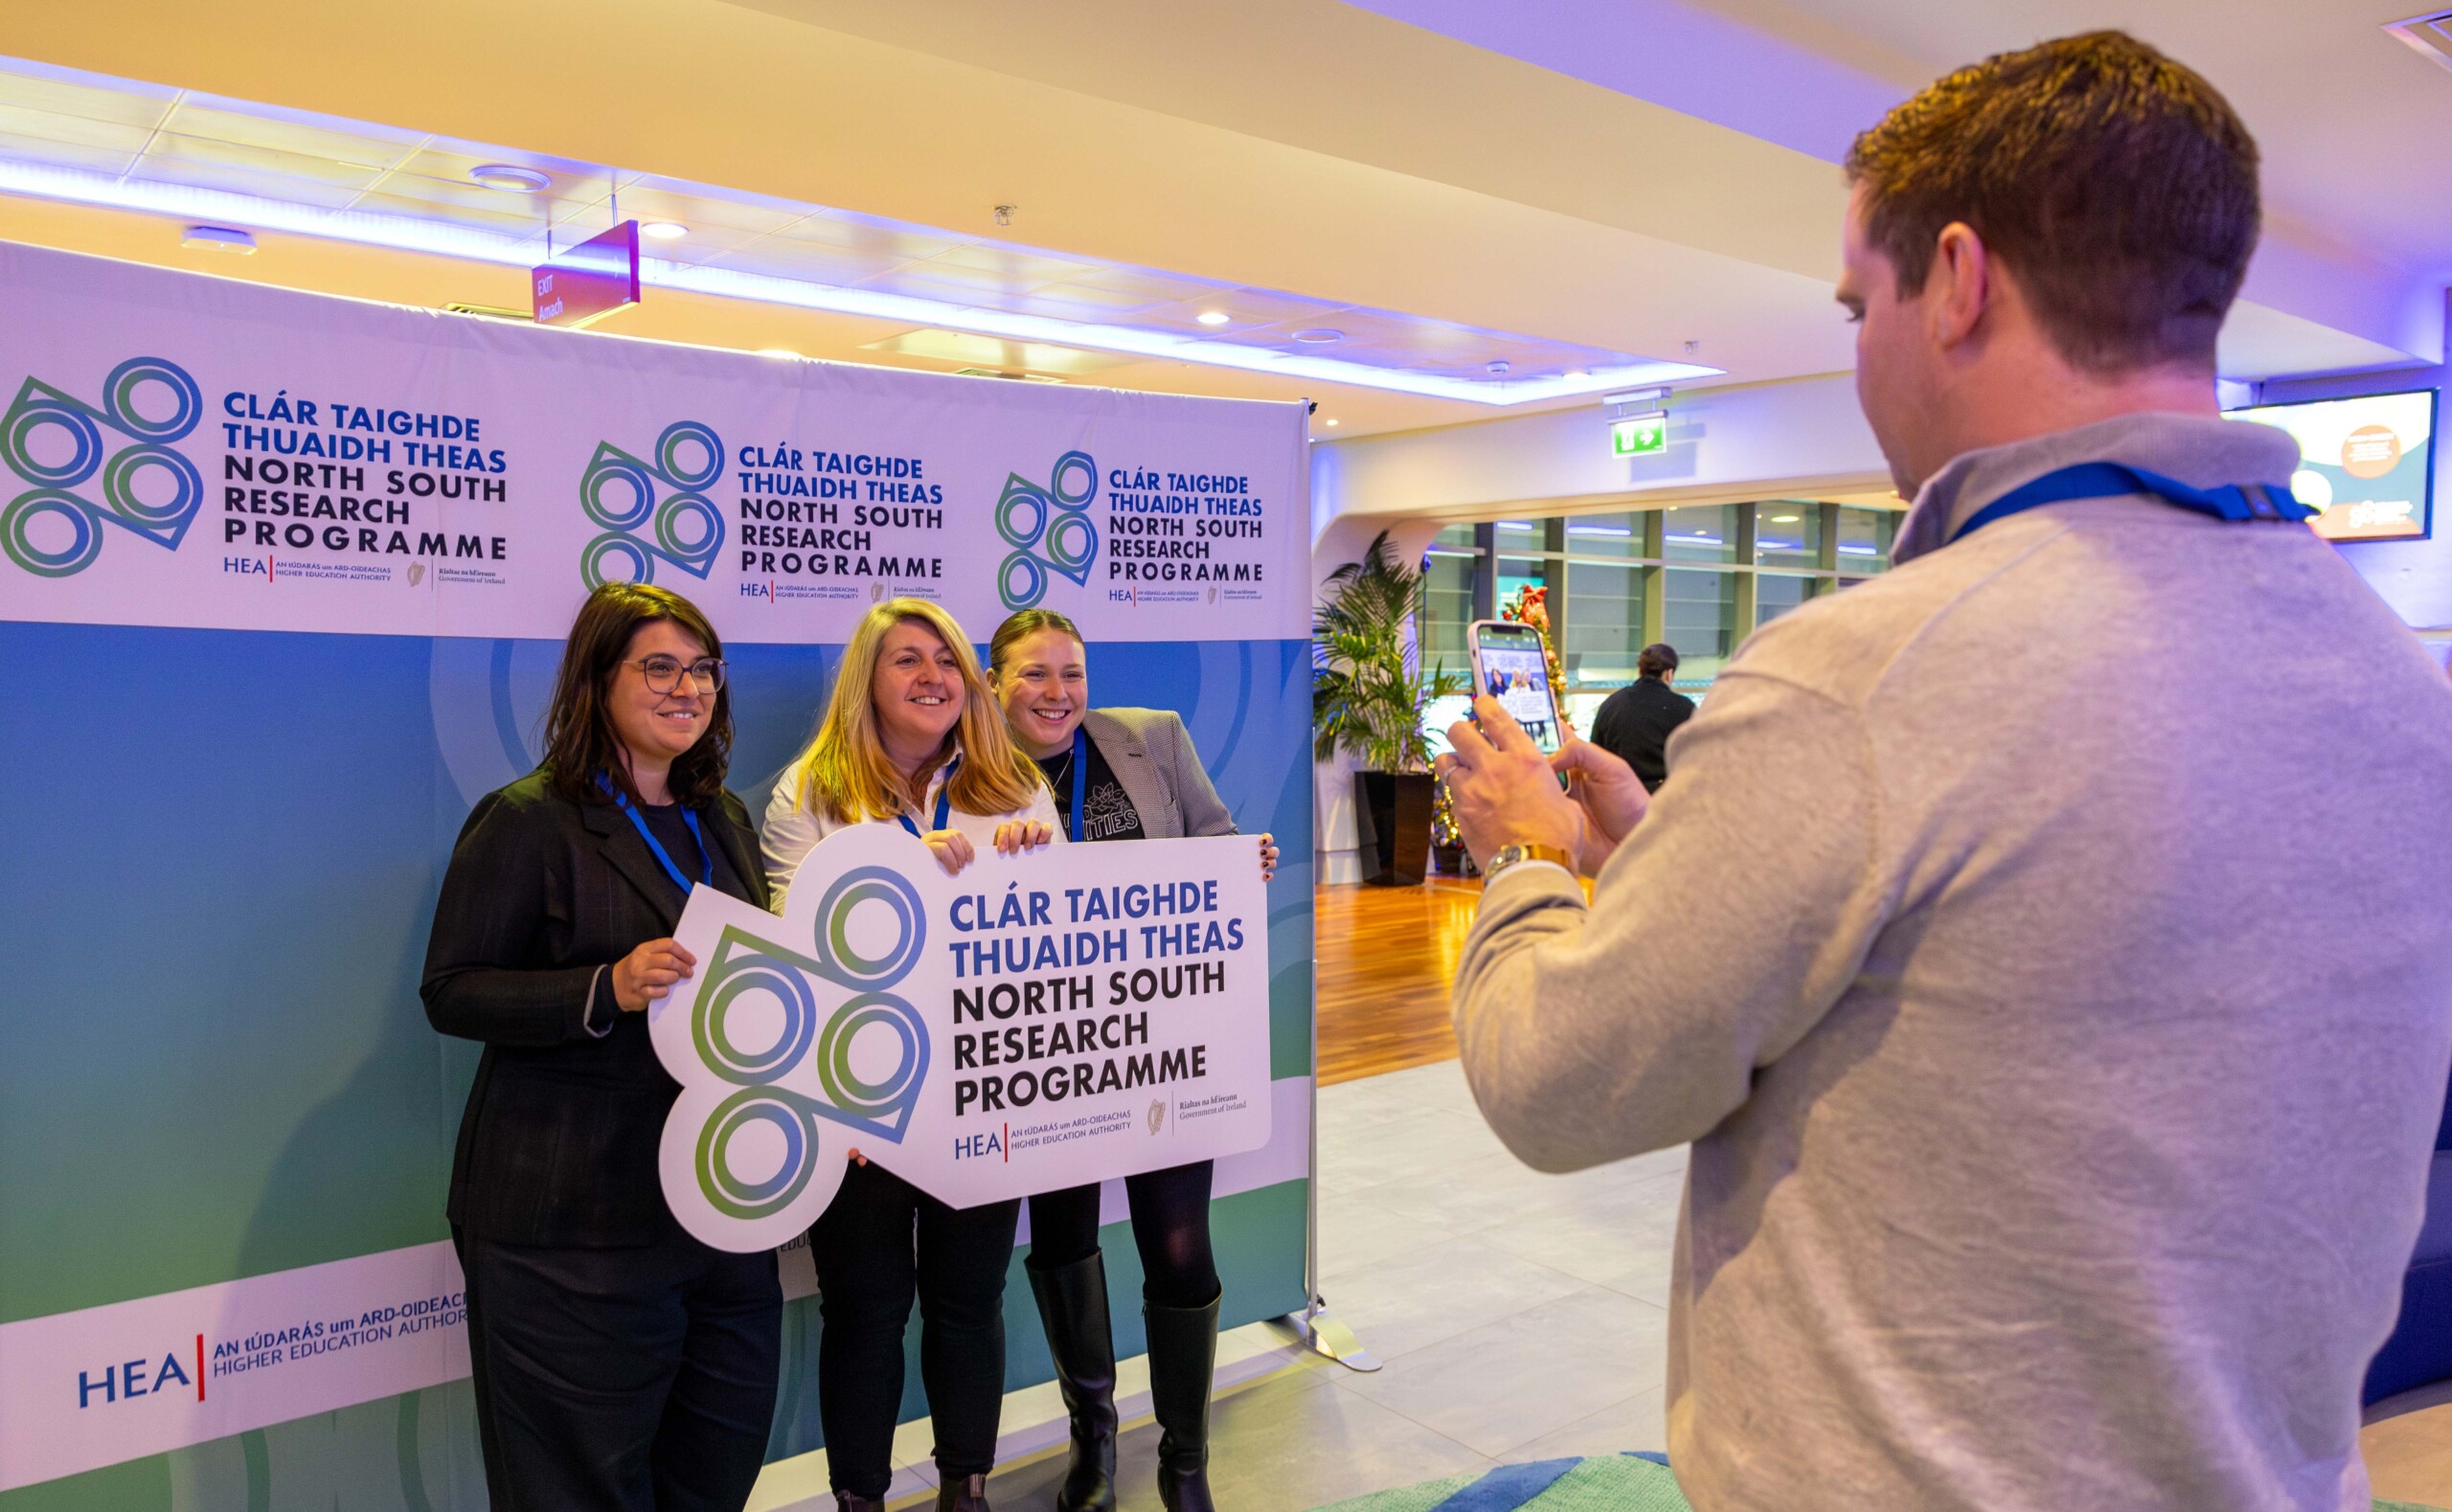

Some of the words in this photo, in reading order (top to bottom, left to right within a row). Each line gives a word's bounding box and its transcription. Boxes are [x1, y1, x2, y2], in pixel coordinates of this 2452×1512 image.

[537, 274, 554, 297] EXIT
[539, 296, 563, 322] Amach
[223, 390, 317, 425] CLÁR
[330, 404, 480, 441] TAIGHDE
[222, 422, 391, 463] THUAIDH
[402, 441, 507, 473] THEAS
[738, 440, 803, 471] CLÁR
[812, 451, 922, 479] TAIGHDE
[224, 455, 364, 491] NORTH
[387, 469, 506, 503] SOUTH
[738, 472, 856, 500] THUAIDH
[866, 481, 942, 505] THEAS
[1109, 465, 1160, 491] CLÁR
[1168, 473, 1248, 494] TAIGHDE
[225, 486, 409, 525] RESEARCH
[740, 498, 838, 524] NORTH
[853, 505, 942, 529] SOUTH
[1109, 493, 1198, 515] THUAIDH
[1205, 497, 1262, 516] THEAS
[224, 518, 506, 560] PROGRAMME
[741, 524, 871, 551] RESEARCH
[1110, 516, 1184, 536] NORTH
[1196, 519, 1262, 538] SOUTH
[1110, 539, 1210, 559] RESEARCH
[224, 556, 267, 575] HEA
[306, 571, 347, 579] EDUCATION
[350, 574, 391, 582] AUTHORITY
[741, 551, 942, 577] PROGRAMME
[1110, 561, 1262, 581] PROGRAMME
[740, 583, 769, 597] HEA
[1109, 590, 1132, 601] HEA
[949, 880, 1052, 932] CLÁR
[1065, 879, 1217, 922] TAIGHDE
[949, 929, 1128, 979] THUAIDH
[1141, 917, 1244, 959] THEAS
[953, 977, 1094, 1024] NORTH
[1108, 960, 1225, 1005] SOUTH
[954, 1011, 1148, 1070] RESEARCH
[955, 1044, 1207, 1117] PROGRAMME
[1179, 1100, 1201, 1110] Rialtas
[1179, 1107, 1217, 1119] Government
[1217, 1104, 1225, 1113] of
[1226, 1100, 1246, 1112] Ireland
[1010, 1129, 1023, 1138] AN
[1072, 1110, 1131, 1127] ARD-OIDEACHAS
[1010, 1139, 1040, 1150] HIGHER
[1042, 1130, 1086, 1144] EDUCATION
[1088, 1121, 1131, 1137] AUTHORITY
[955, 1132, 1002, 1160] HEA
[213, 1339, 240, 1360] AN
[244, 1321, 325, 1351] tÚDARÁS
[329, 1318, 355, 1335] um
[359, 1291, 467, 1329] ARD-OIDEAC
[214, 1348, 284, 1379] HIGHER
[289, 1324, 393, 1361] EDUCATION
[79, 1352, 191, 1409] HEA
